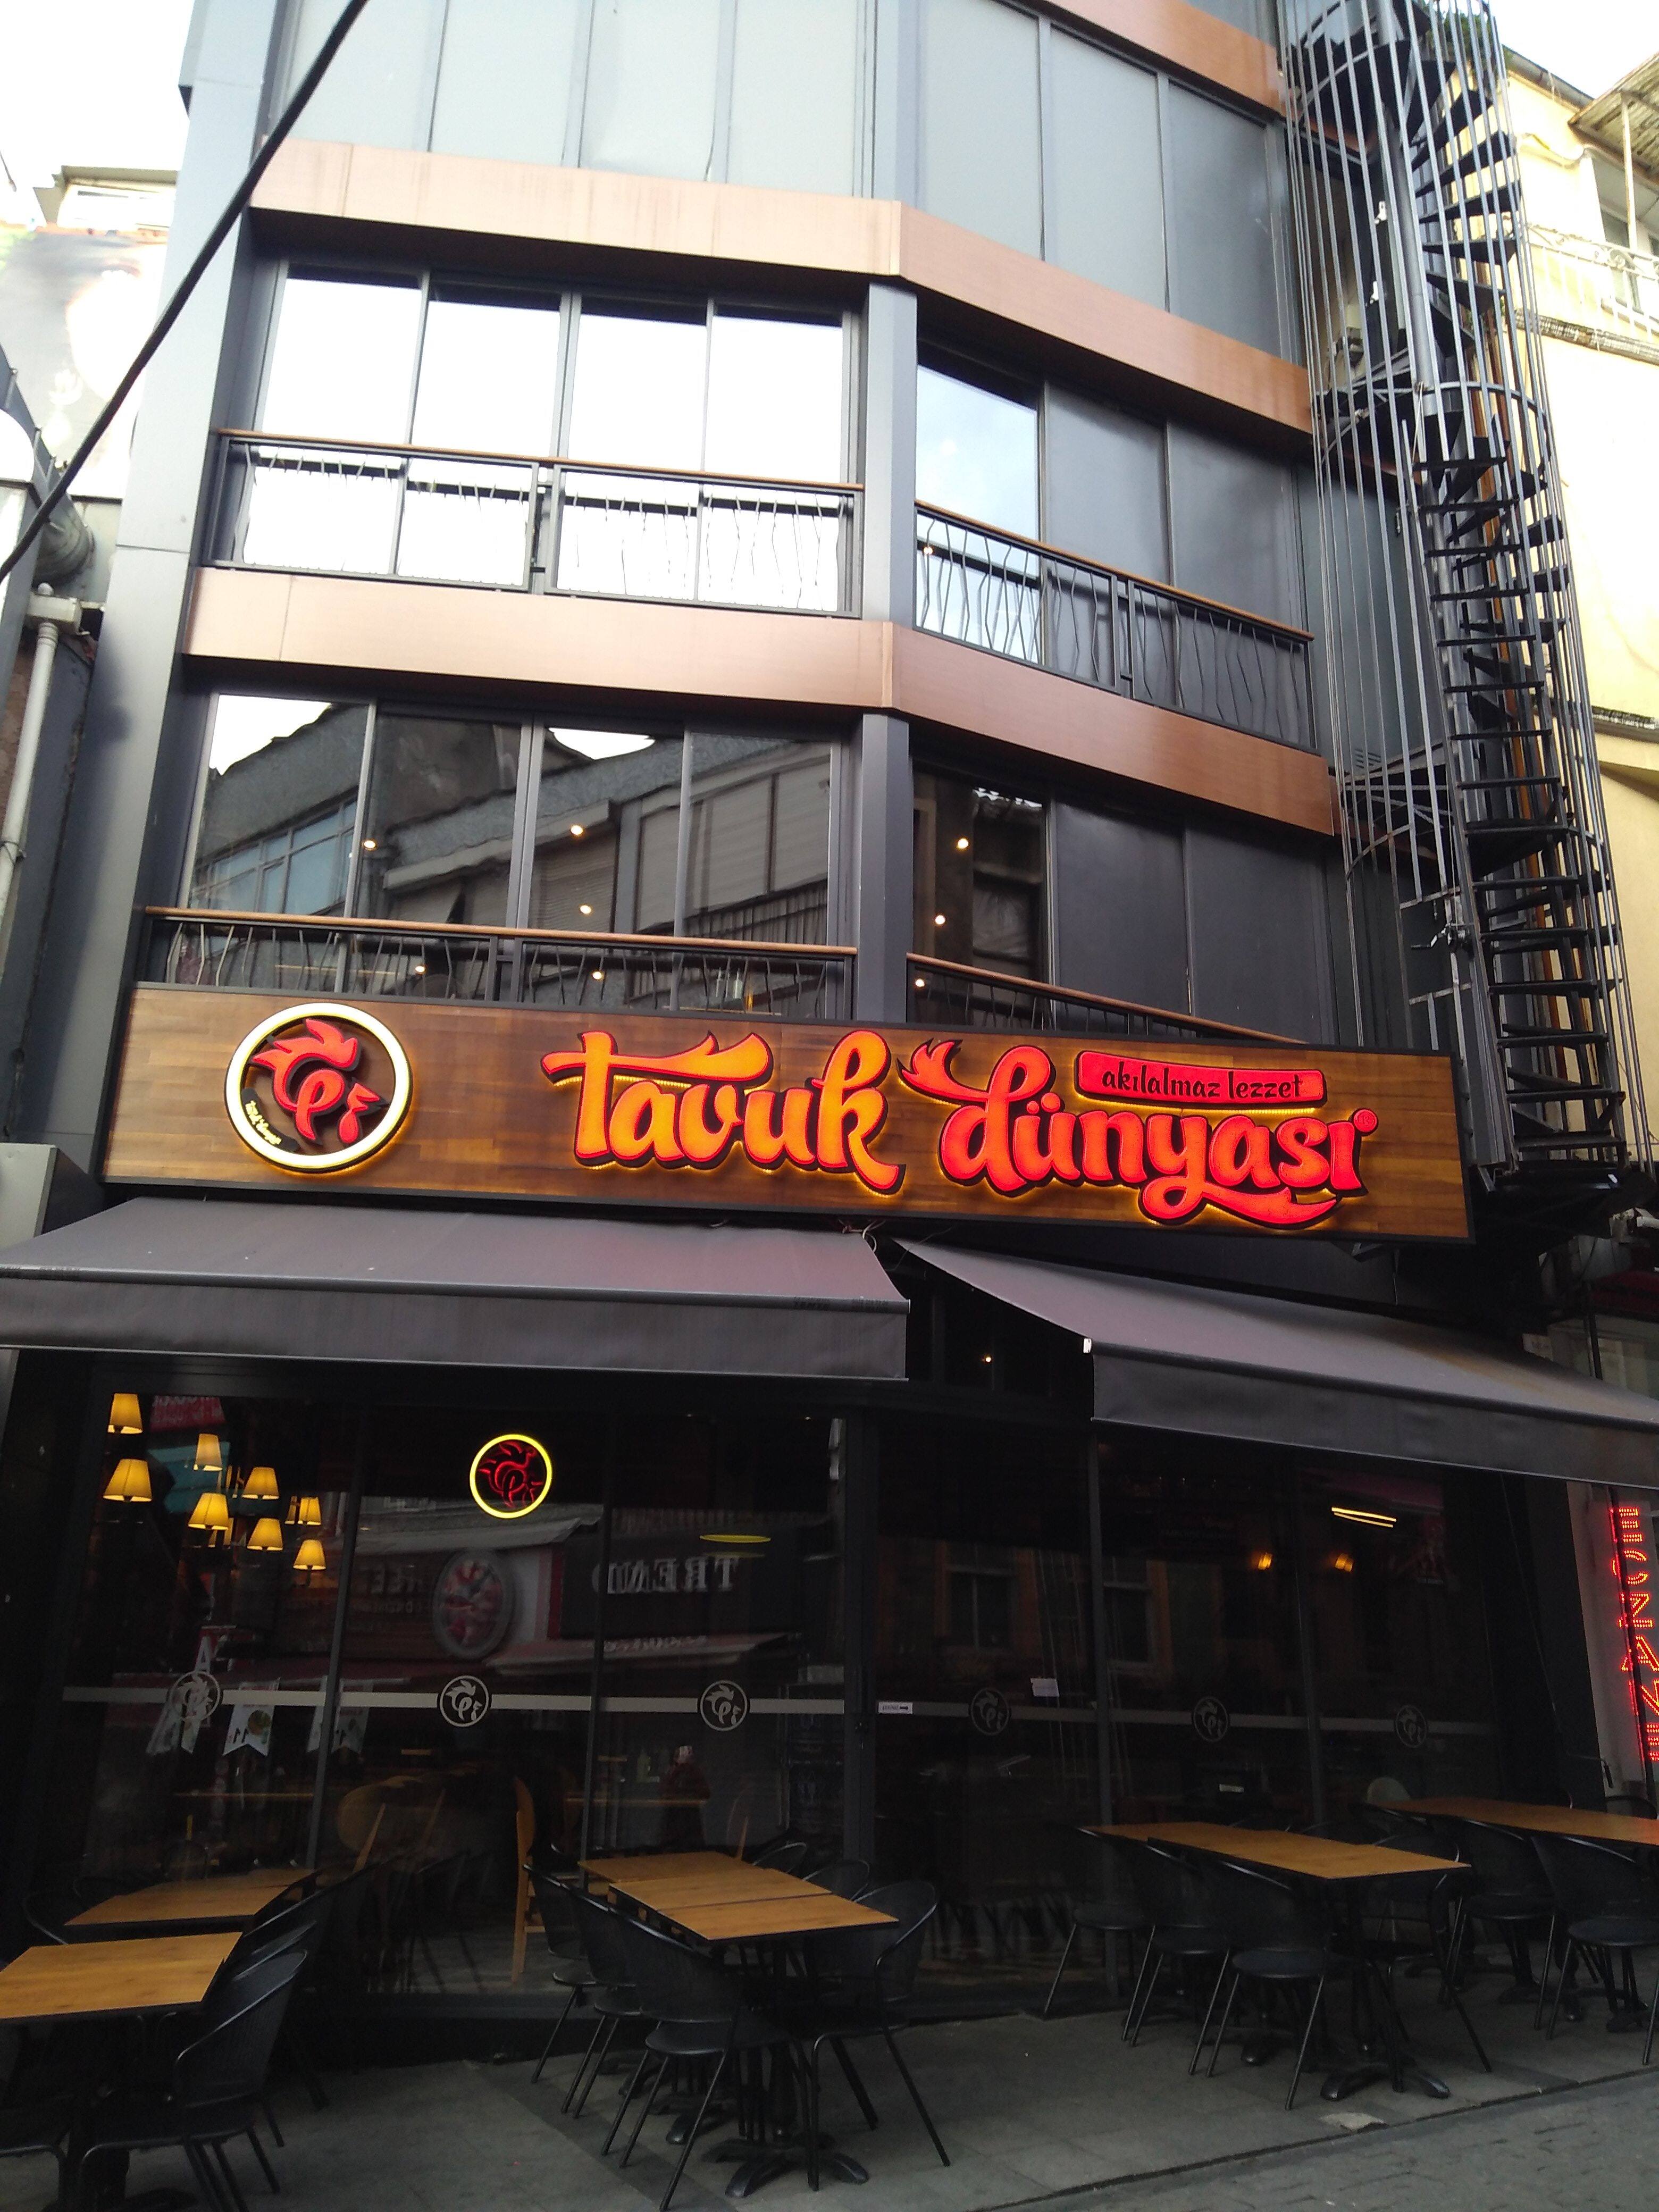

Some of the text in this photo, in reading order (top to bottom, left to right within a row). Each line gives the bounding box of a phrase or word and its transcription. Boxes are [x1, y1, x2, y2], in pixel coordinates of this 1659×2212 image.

[541, 1030, 905, 1194] tavuk
[1102, 1061, 1302, 1099] akılalmaz lezzet
